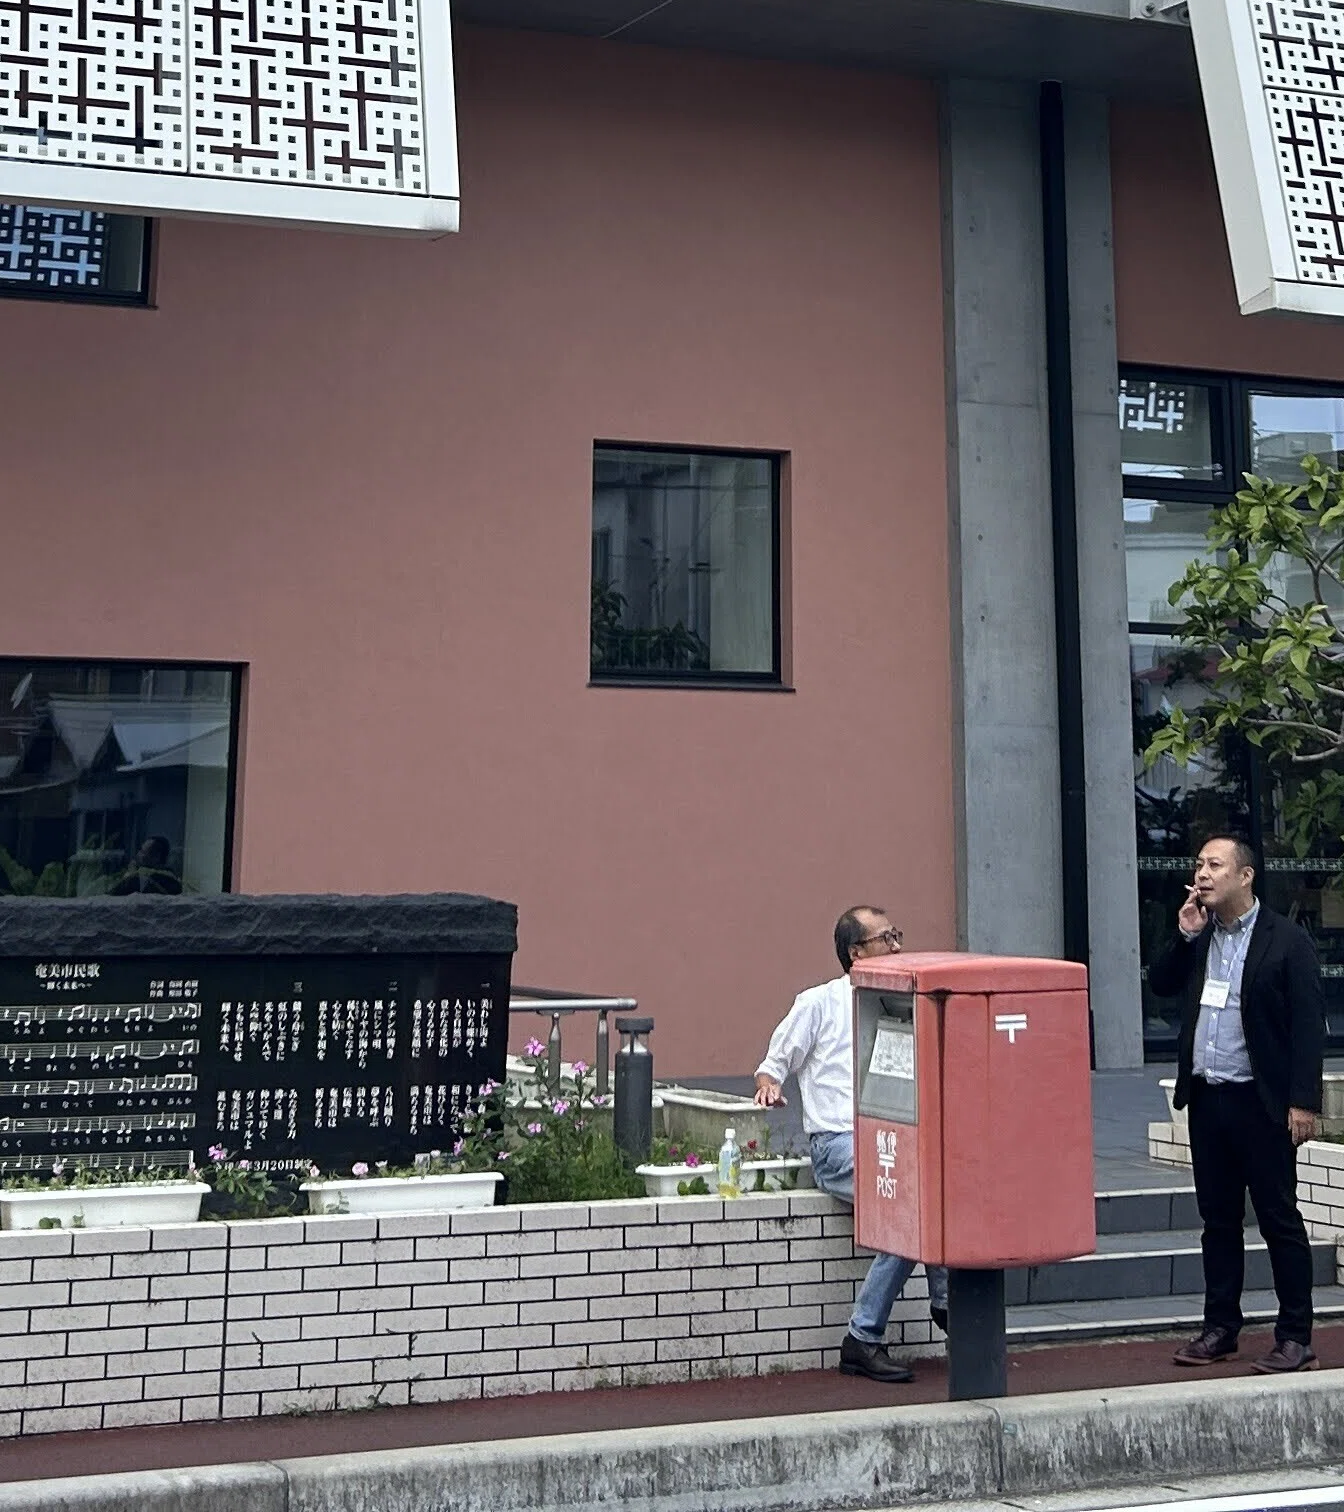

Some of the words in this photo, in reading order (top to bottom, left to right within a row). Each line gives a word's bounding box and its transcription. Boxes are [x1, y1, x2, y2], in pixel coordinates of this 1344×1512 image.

[35, 963, 101, 979] 奄美市民歌
[876, 1129, 898, 1157] 郵便
[876, 1175, 898, 1199] POST
